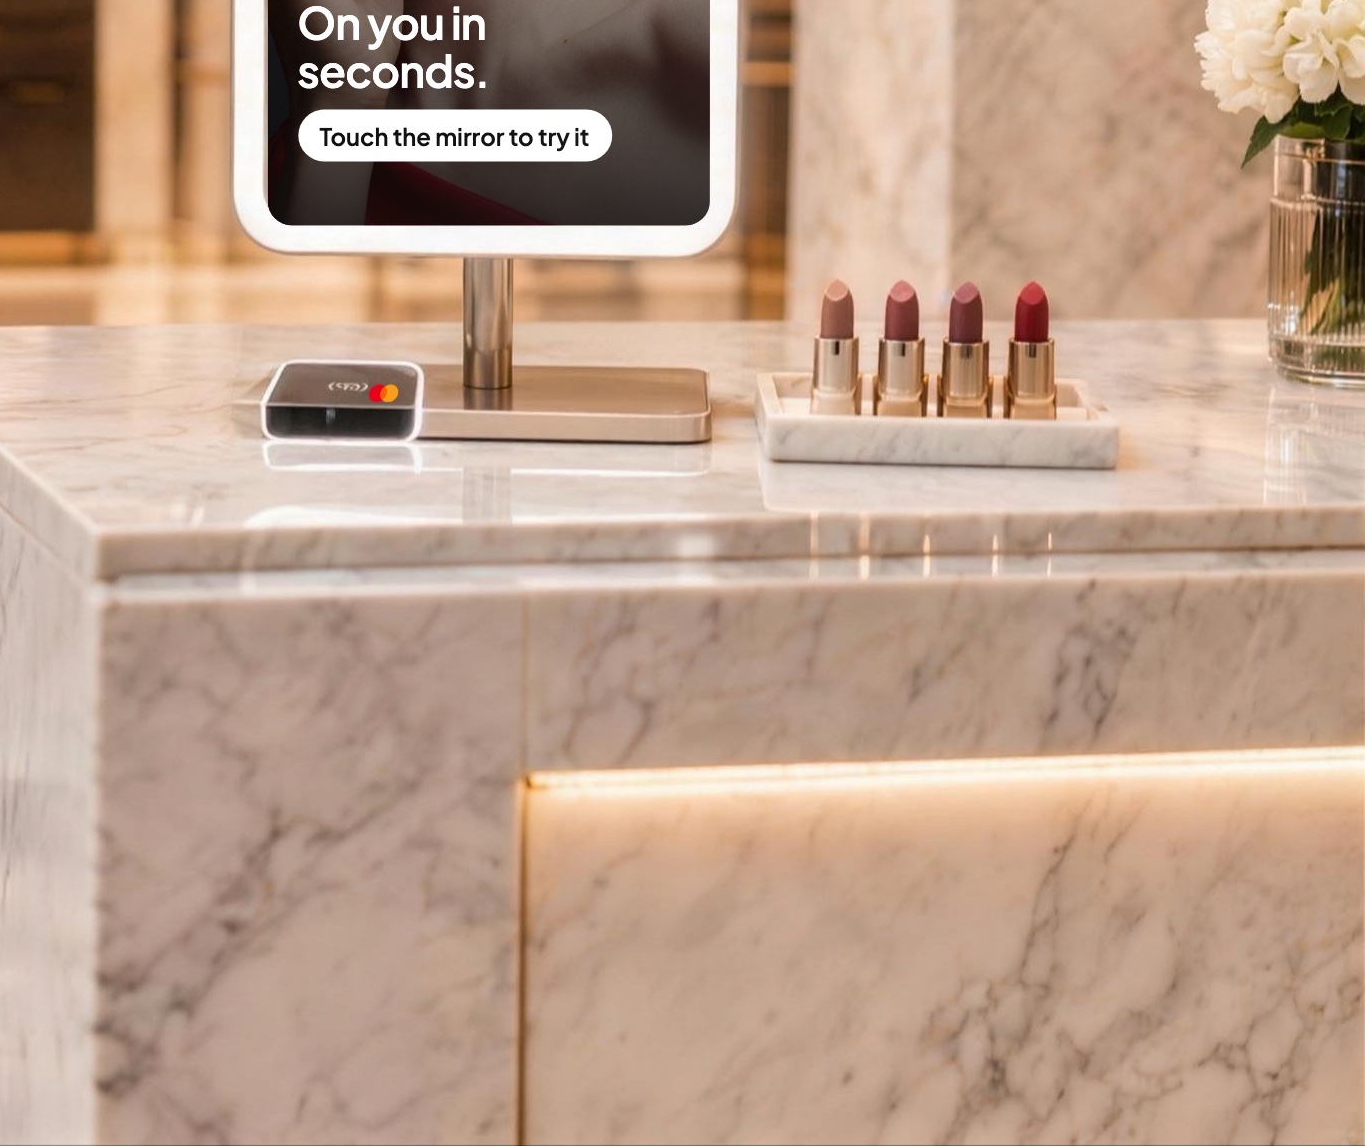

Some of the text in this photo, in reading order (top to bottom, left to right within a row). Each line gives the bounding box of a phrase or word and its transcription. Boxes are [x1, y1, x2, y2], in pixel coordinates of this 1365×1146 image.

[299, 5, 485, 50] On you in
[298, 53, 486, 89] seconds.
[319, 127, 589, 152] Touch the mirror to try it
